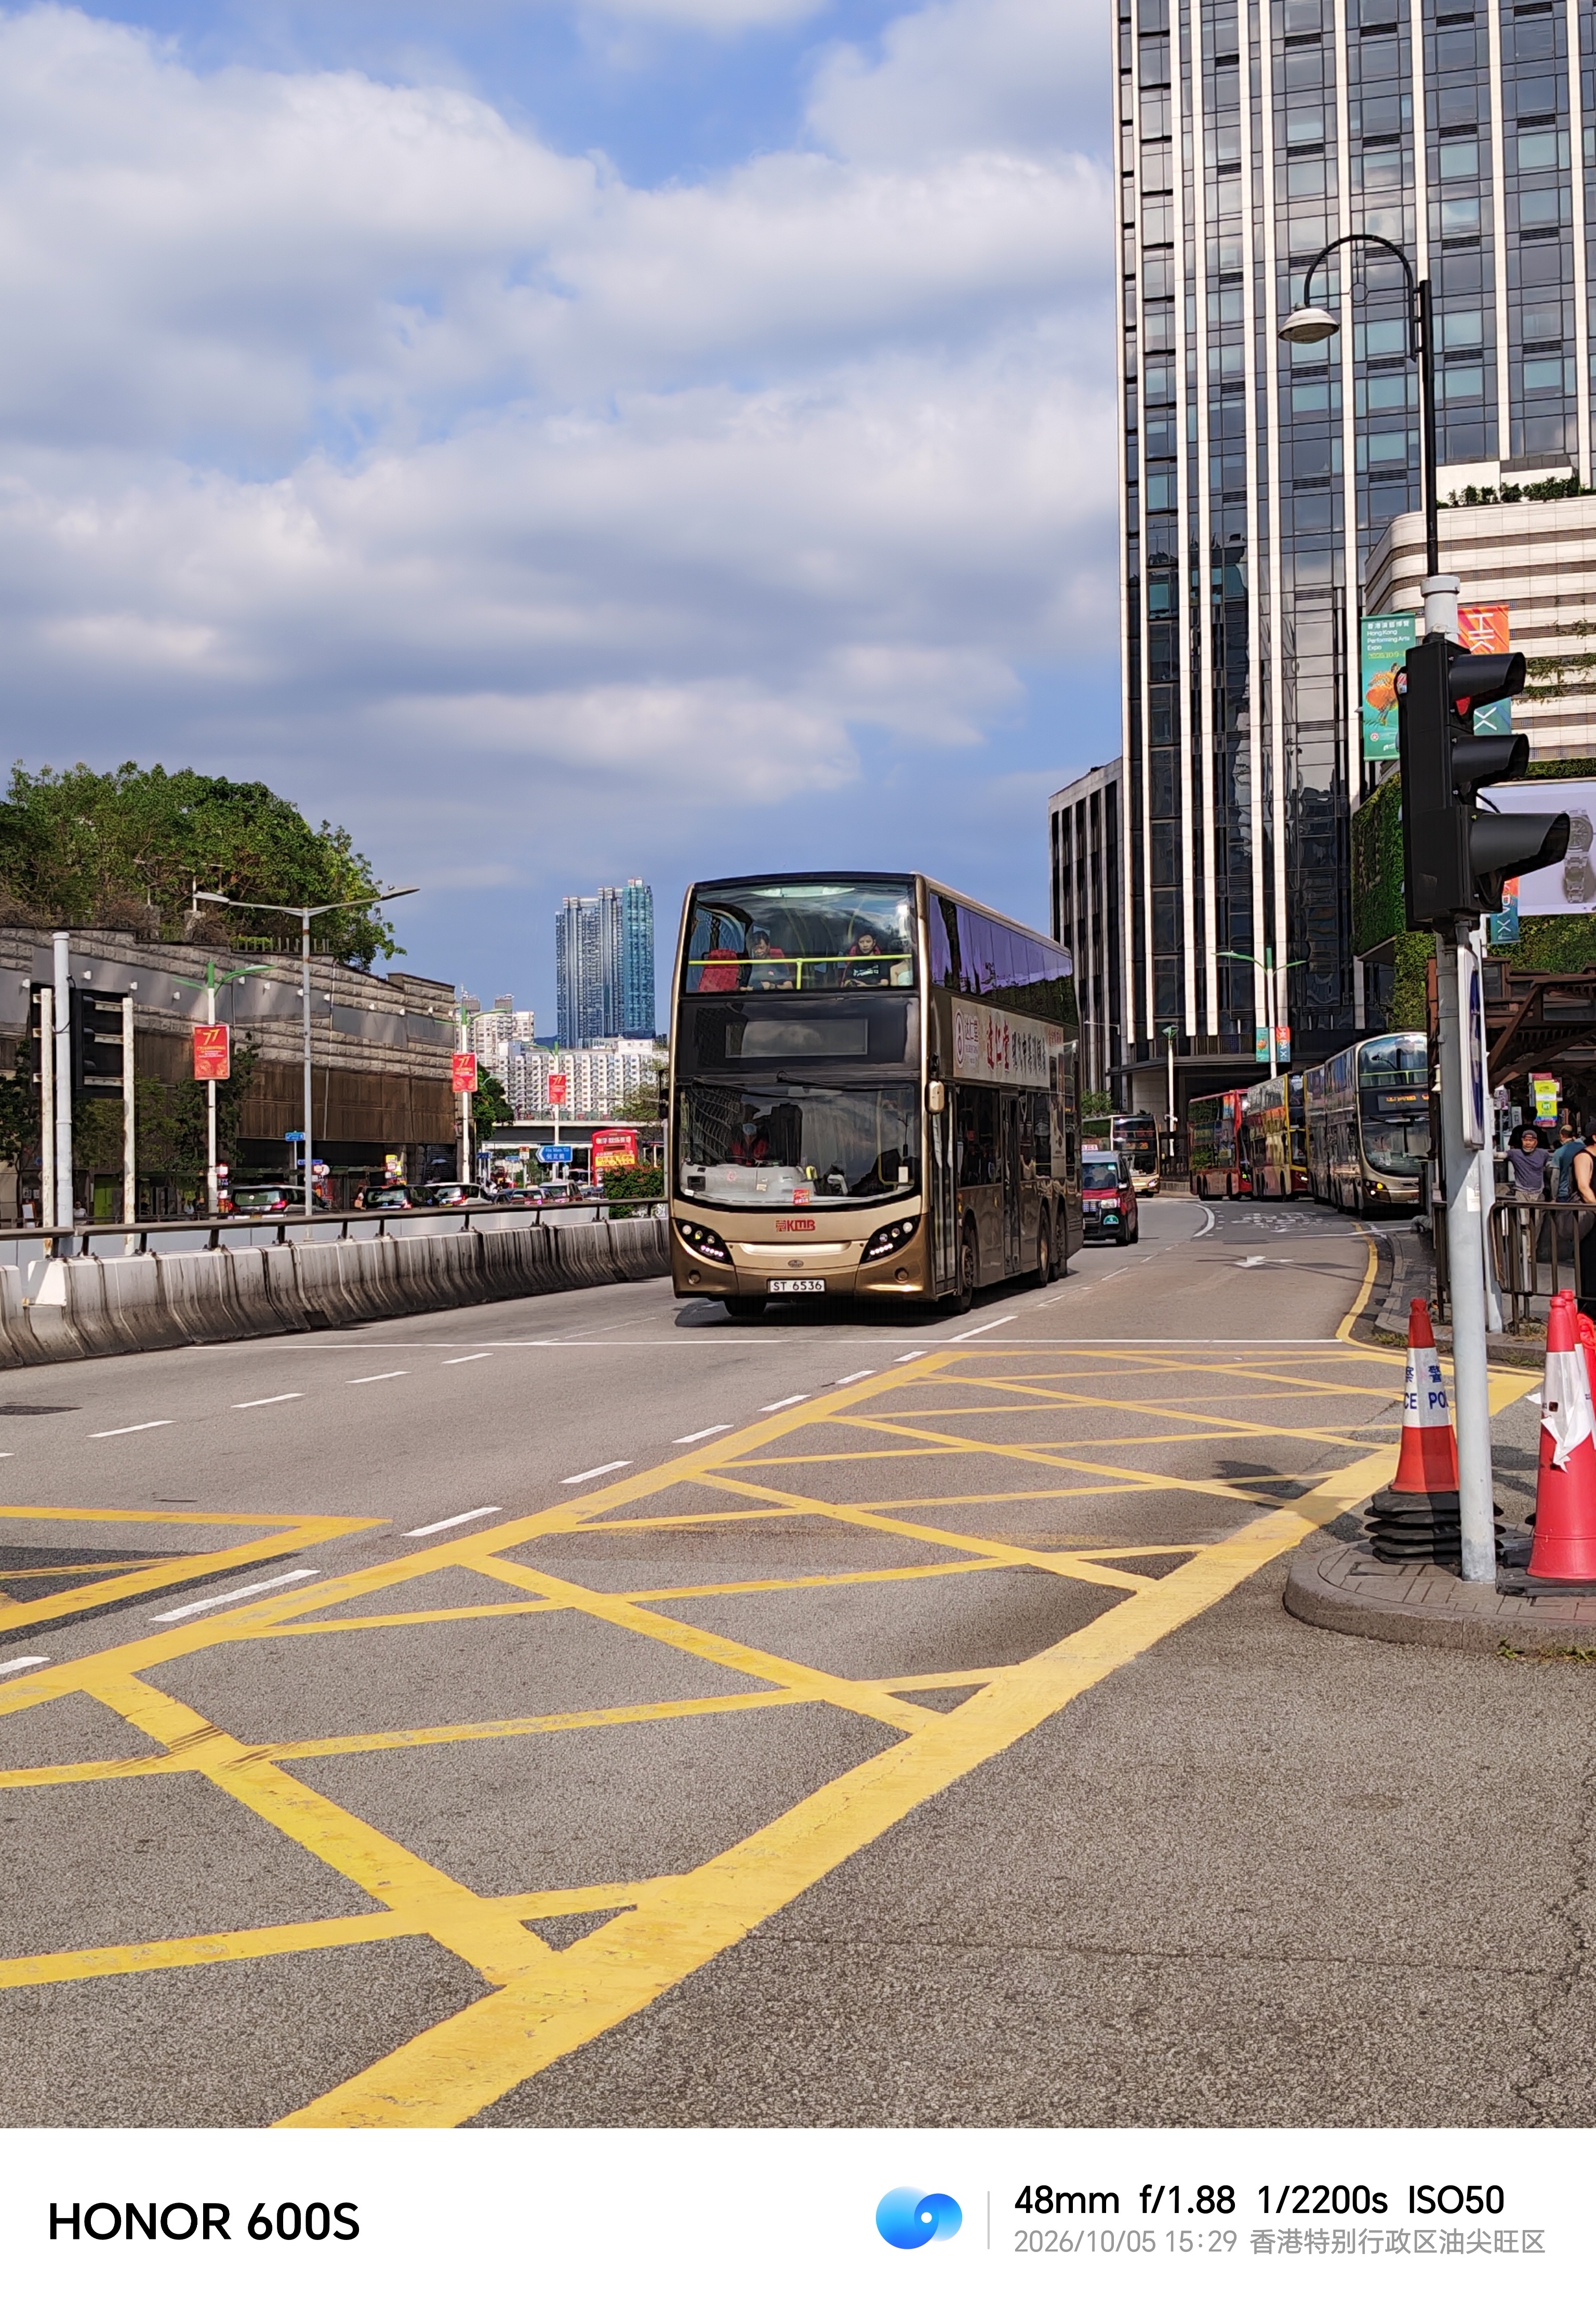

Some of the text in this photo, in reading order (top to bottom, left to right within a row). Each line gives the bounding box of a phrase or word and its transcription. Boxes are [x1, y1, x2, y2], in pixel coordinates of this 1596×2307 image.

[787, 1219, 816, 1232] KMB
[774, 1281, 822, 1291] ST 6536
